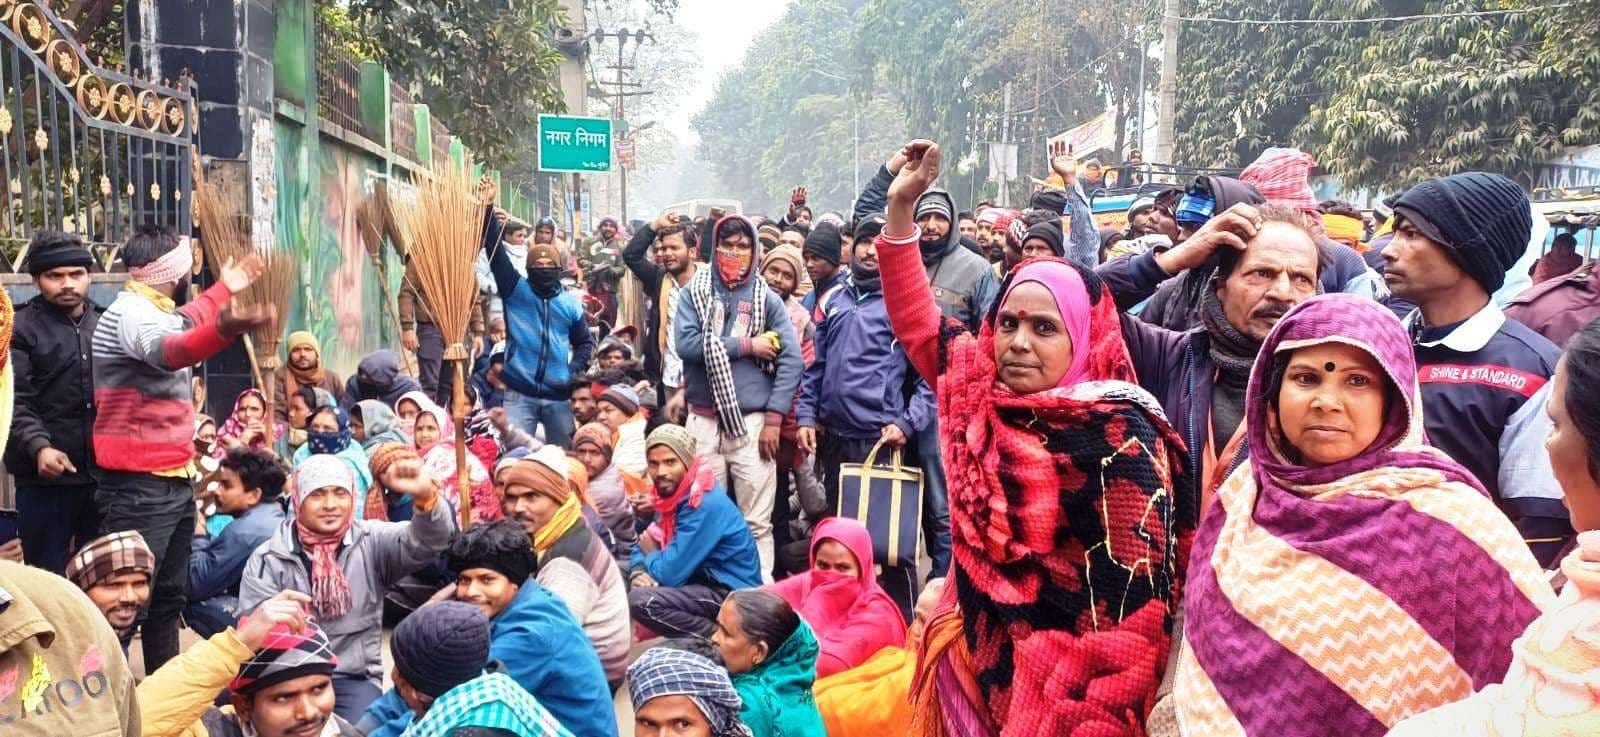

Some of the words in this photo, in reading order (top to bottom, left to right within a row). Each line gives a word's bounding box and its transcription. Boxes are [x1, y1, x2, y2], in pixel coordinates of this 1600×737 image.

[545, 130, 572, 146] नगर
[575, 127, 607, 148] निगम
[1430, 367, 1460, 379] SHINE
[1462, 370, 1467, 380] &
[1469, 368, 1527, 389] STANDARD
